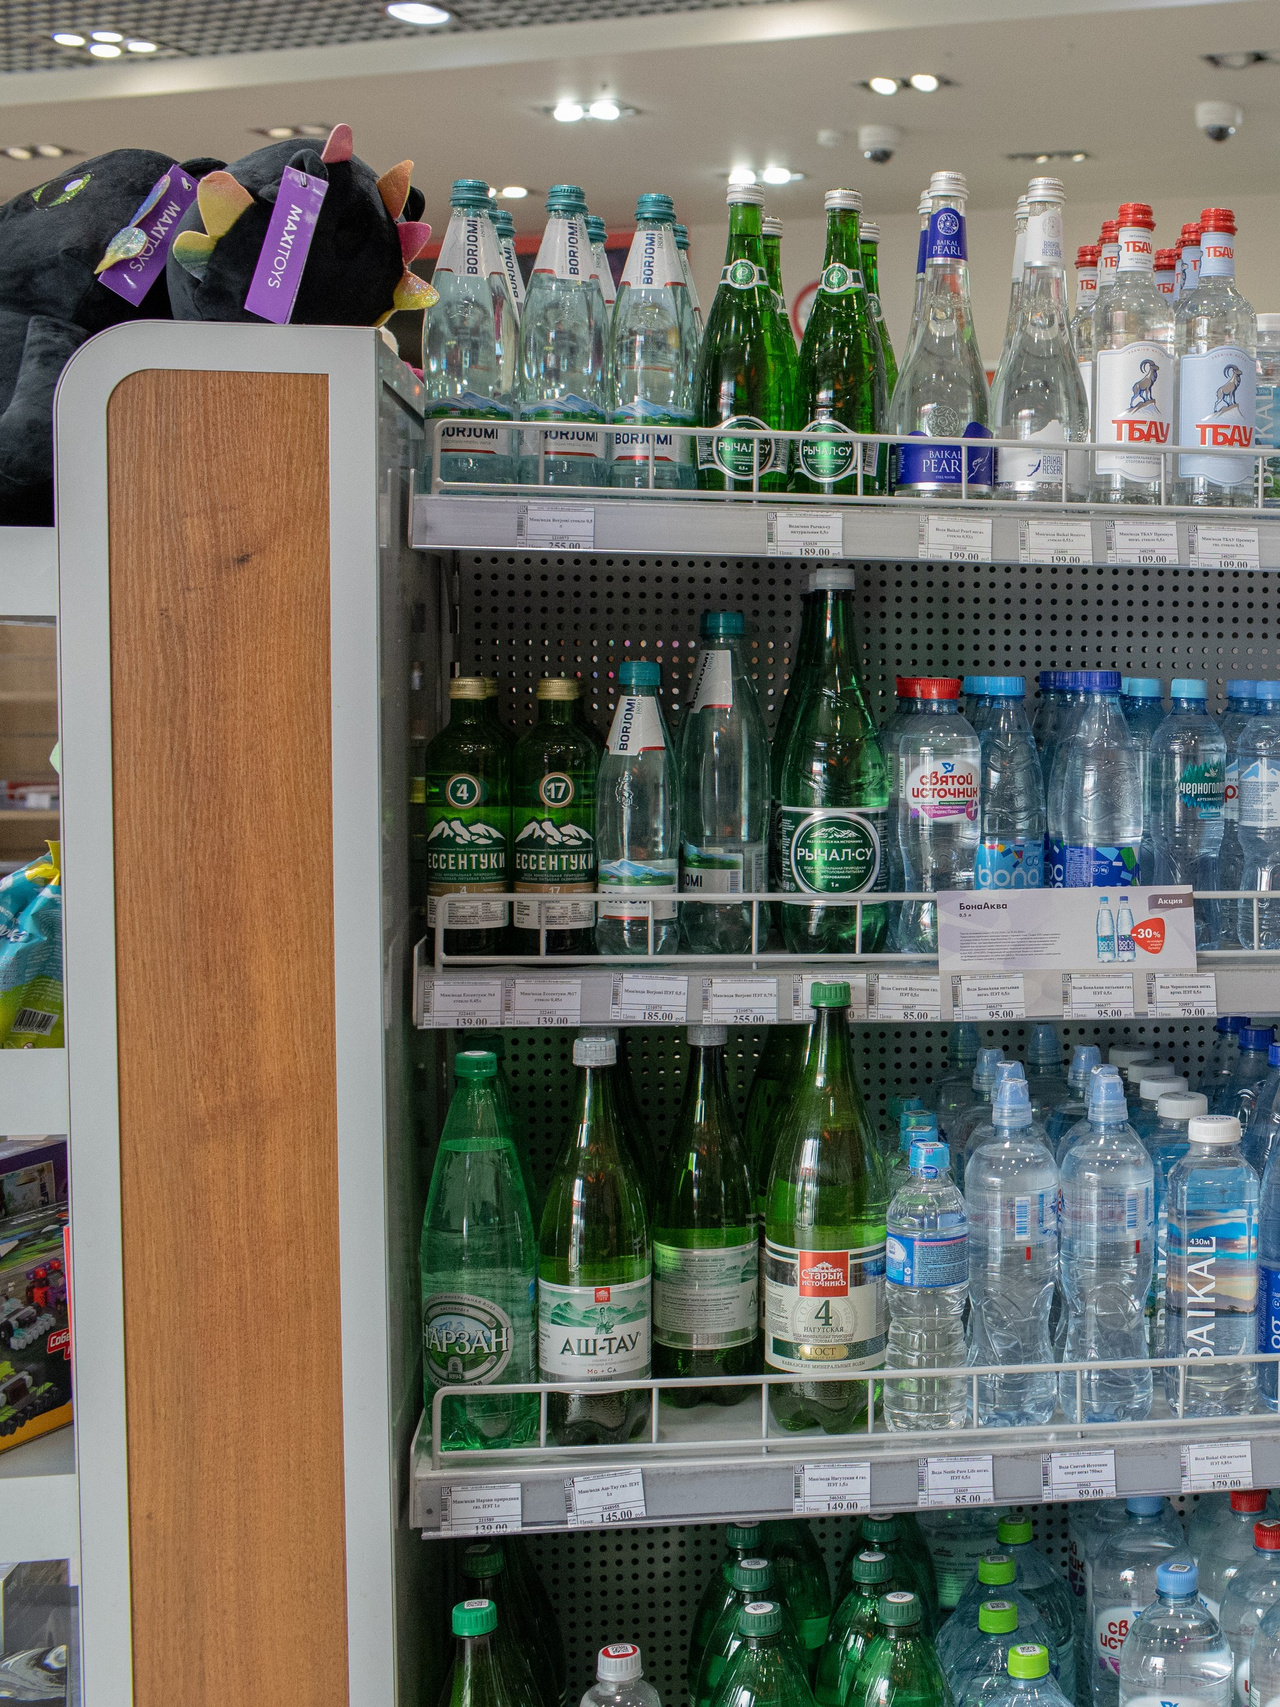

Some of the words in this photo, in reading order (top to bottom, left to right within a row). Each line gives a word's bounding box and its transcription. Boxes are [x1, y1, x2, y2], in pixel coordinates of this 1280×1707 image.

[130, 199, 182, 274] MAXITOYS
[267, 203, 304, 289] MAXITOYS
[466, 219, 479, 275] BORJOMI
[568, 221, 579, 276] BORJOMI
[932, 246, 962, 256] PEARL
[1124, 241, 1152, 254] ТБАУ
[1206, 246, 1234, 259] ТБАУ
[642, 232, 656, 285] BORJOMI
[503, 246, 519, 299] BORJOMI
[1111, 419, 1170, 444] ТБАУ
[1195, 424, 1253, 448] ТБАУ
[614, 432, 672, 445] BORJOMI
[718, 441, 771, 454] РЫЧАЛСУ
[929, 450, 962, 459] BAIKAL
[799, 548, 830, 557] 189.00
[949, 552, 979, 561] 199.00
[1137, 555, 1167, 563] 109.00
[1051, 556, 1080, 564] 199.00
[1218, 560, 1248, 568] 109.00
[619, 698, 637, 751] BORJOMI
[919, 769, 973, 785] святой
[456, 783, 468, 800] 4
[547, 782, 566, 799] 17
[912, 786, 978, 799] источник
[427, 852, 505, 869] ЕССЕНТУКИ
[516, 852, 594, 870] ЕССЕНТУКИ
[959, 901, 1008, 912] БонаАква
[1157, 897, 1183, 905] Акция
[1131, 928, 1161, 938] -30%
[642, 1012, 673, 1021] 185.00
[733, 1015, 764, 1023] 255.00
[903, 1011, 928, 1020] 85.00
[989, 1010, 1014, 1018] 95.00
[1097, 1009, 1122, 1018] 95.00
[1181, 1008, 1207, 1017] 79.00
[455, 1018, 488, 1026] 139.00
[536, 1016, 568, 1025] 139.00
[801, 1269, 844, 1282] Старый
[1187, 1236, 1216, 1365] BAIKAL
[814, 1300, 833, 1326] 4
[423, 1326, 510, 1354] НАРЗАН
[560, 1331, 640, 1357] АШ-ТАУ
[809, 1346, 837, 1357] ГОСТ
[1211, 1479, 1241, 1489] 179.00
[955, 1494, 981, 1504] 85.00
[1078, 1489, 1103, 1498] 89.00
[826, 1502, 858, 1511] 149.00
[600, 1510, 632, 1523] 145.00
[475, 1523, 508, 1534] 139.00
